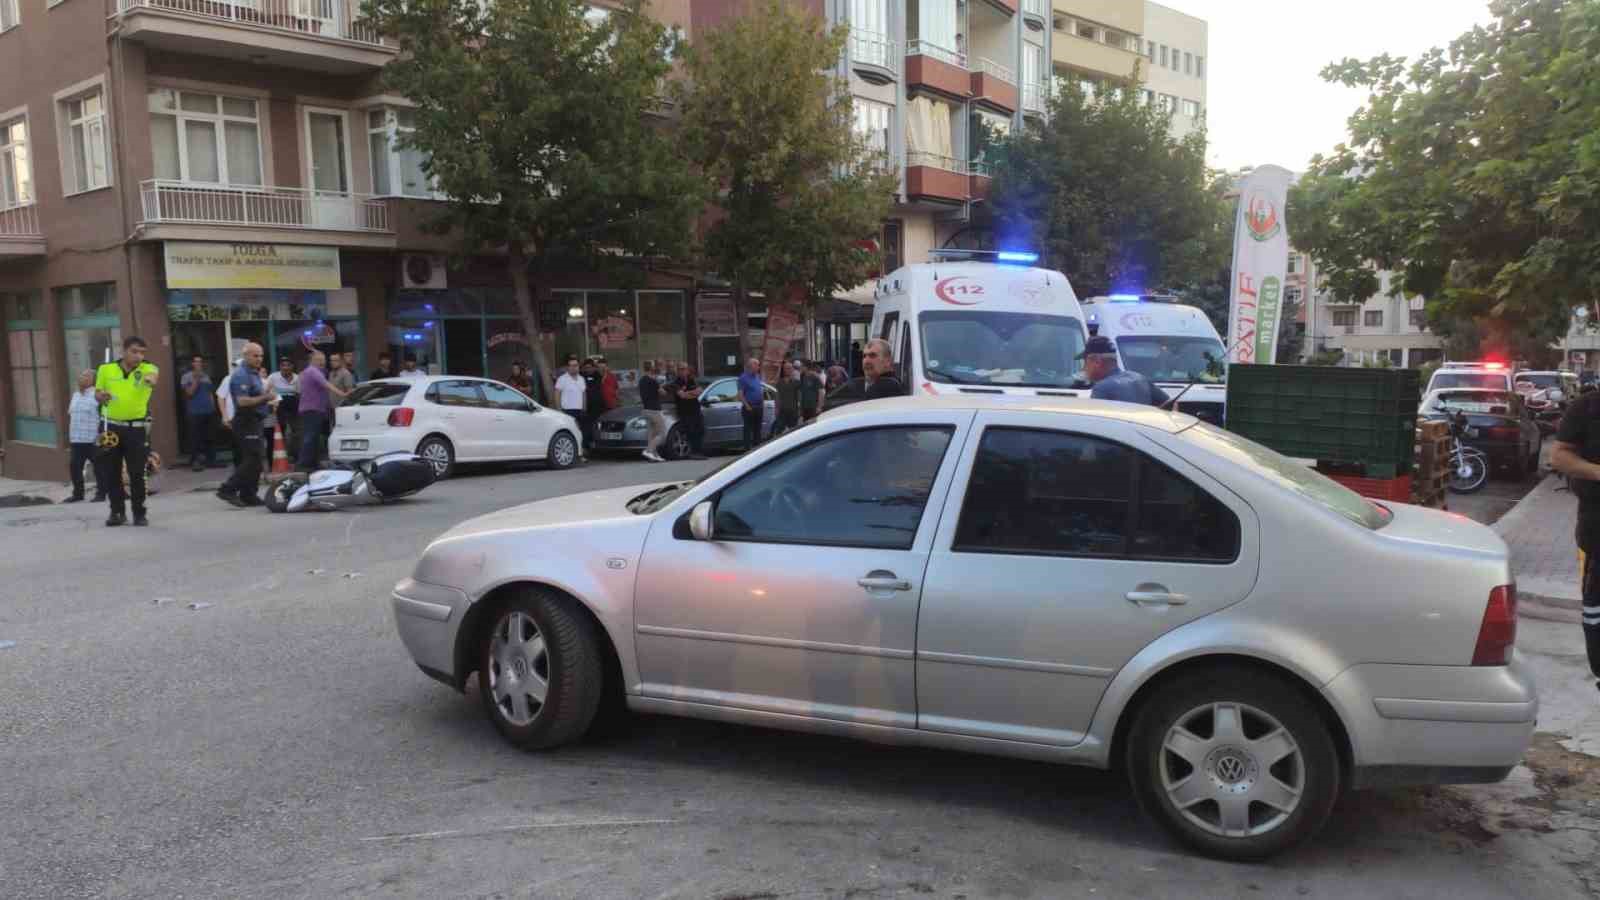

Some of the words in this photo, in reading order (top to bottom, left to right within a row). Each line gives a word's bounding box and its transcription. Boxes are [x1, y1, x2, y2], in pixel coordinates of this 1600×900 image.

[231, 243, 277, 257] TOLGA
[945, 285, 985, 295] 112
[1259, 283, 1277, 344] market
